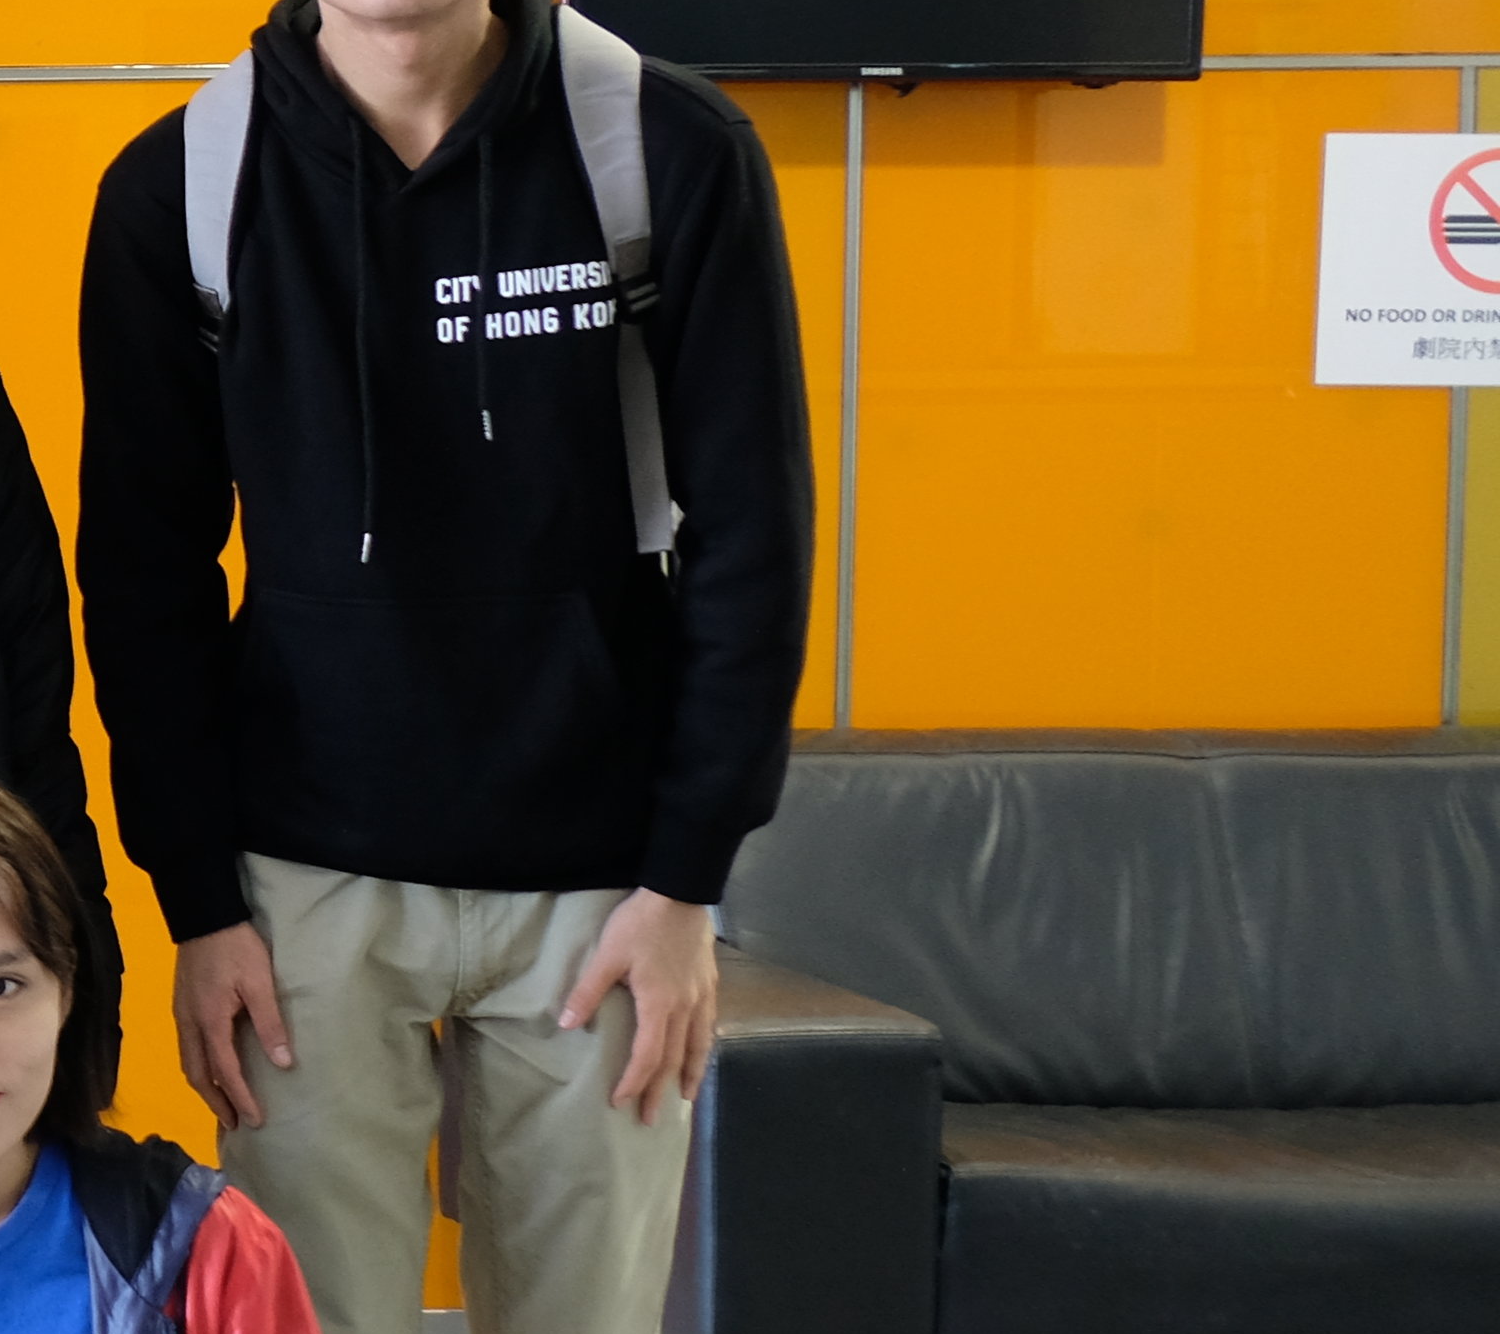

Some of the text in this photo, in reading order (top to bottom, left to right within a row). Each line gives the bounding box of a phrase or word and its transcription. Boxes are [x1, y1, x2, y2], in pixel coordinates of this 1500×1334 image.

[436, 316, 470, 344] OF
[485, 306, 560, 340] HONG
[1345, 308, 1373, 323] NO
[1378, 308, 1428, 323] FOOD
[1432, 308, 1456, 323] OR
